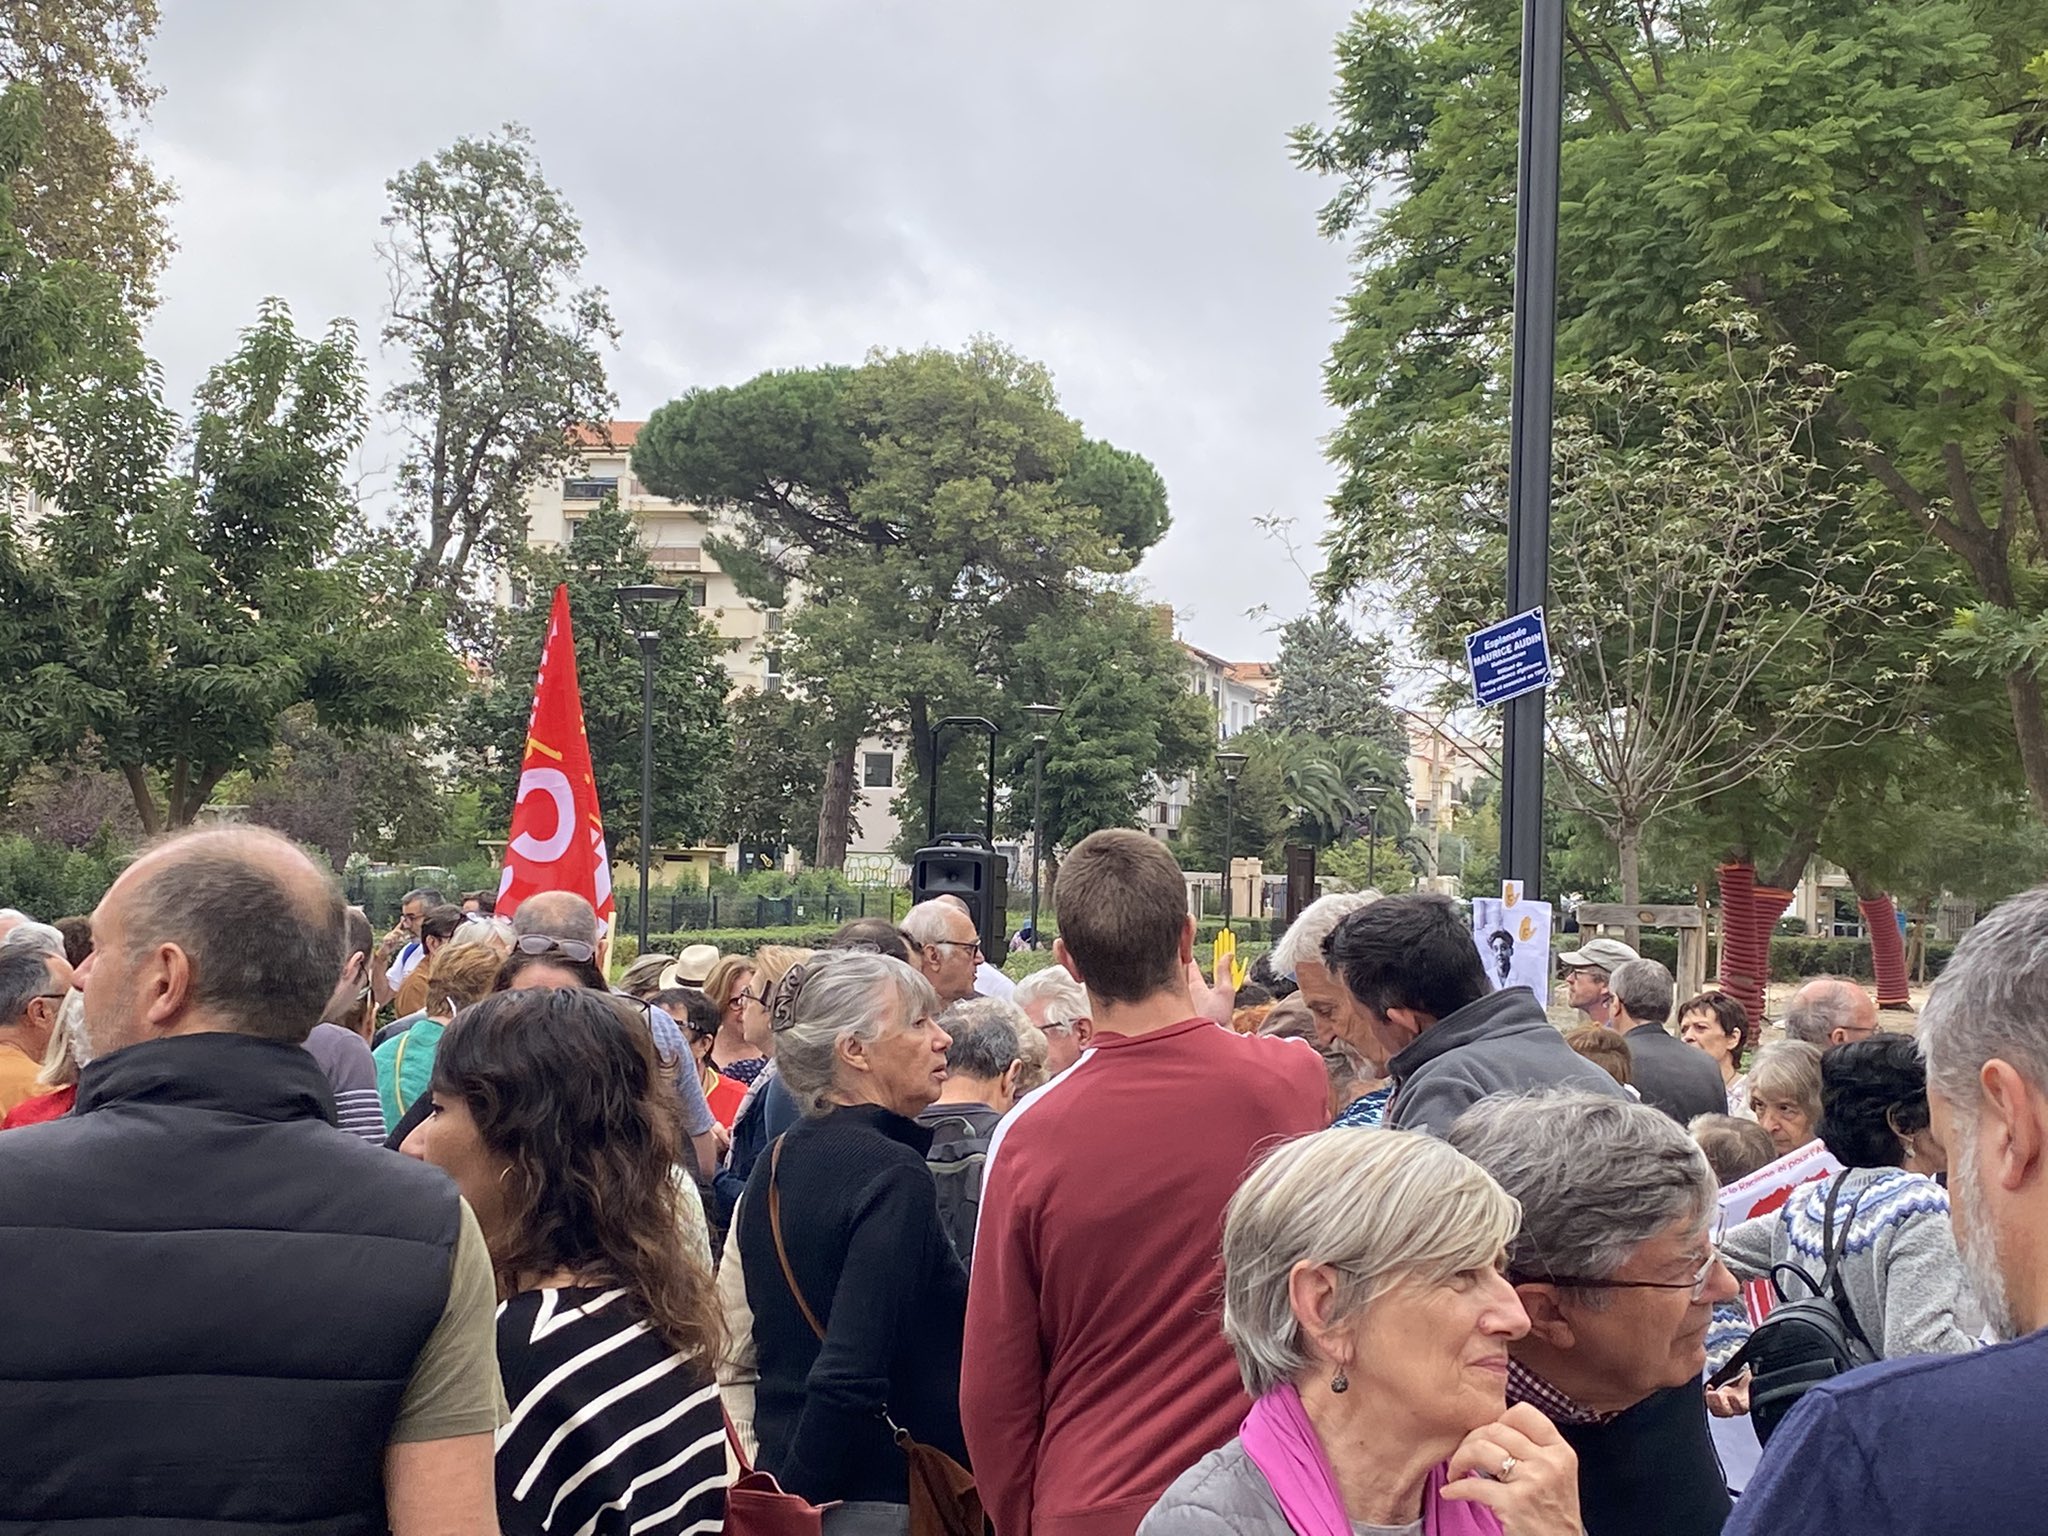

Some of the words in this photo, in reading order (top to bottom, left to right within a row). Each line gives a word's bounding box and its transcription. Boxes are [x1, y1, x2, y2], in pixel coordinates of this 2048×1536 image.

[1473, 644, 1512, 667] MAURICE
[1514, 632, 1542, 651] AUDIN
[1484, 627, 1527, 650] Esplanade
[1788, 1154, 1810, 1171] pour
